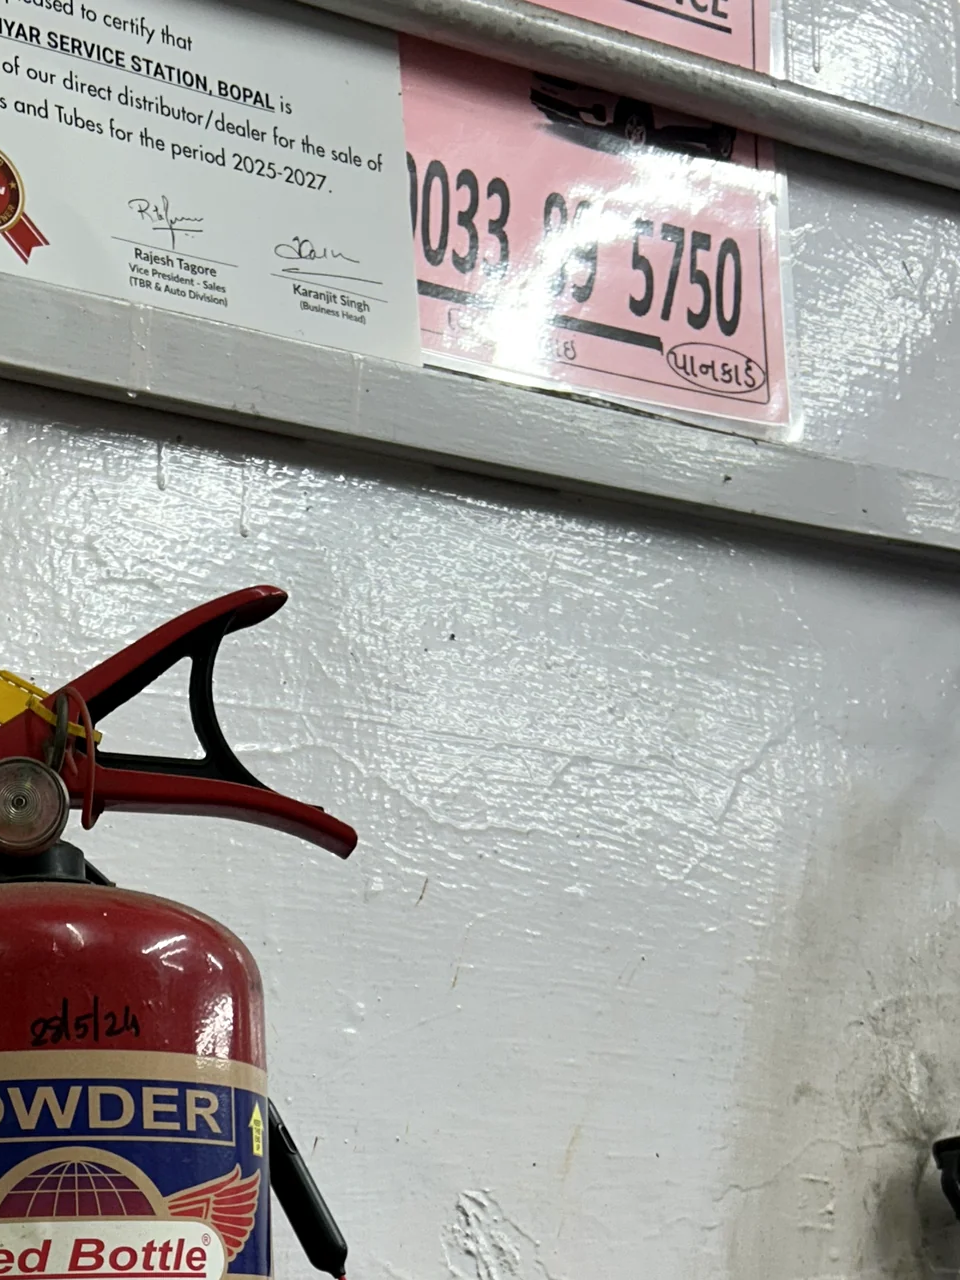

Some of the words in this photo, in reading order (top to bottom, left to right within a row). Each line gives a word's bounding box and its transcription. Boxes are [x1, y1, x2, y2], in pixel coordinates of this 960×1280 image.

[80, 4, 97, 23] to
[103, 13, 156, 45] certify
[161, 24, 192, 51] that
[47, 32, 125, 68] SERVICE
[131, 55, 213, 96] STATION,
[218, 80, 275, 110] BOPAL
[280, 96, 292, 115] is
[2, 56, 20, 75] of
[26, 67, 56, 86] our
[63, 71, 112, 101] direct
[117, 86, 267, 142] distributor/dealer
[273, 126, 295, 150] for
[301, 135, 325, 158] the
[331, 147, 362, 167] sale
[367, 154, 383, 172] of
[14, 99, 48, 120] and
[54, 104, 103, 135] Tubes
[109, 118, 133, 143] for
[139, 127, 165, 152] the
[171, 143, 225, 167] period
[128, 263, 150, 278] Vice
[151, 268, 194, 287] President
[203, 280, 226, 294] Sales
[134, 247, 174, 269] Rajesh
[176, 257, 217, 278] Tagore
[628, 217, 741, 337] 5750
[129, 277, 152, 291] (TBR
[164, 284, 187, 299] Auto
[189, 289, 228, 308] Division)
[293, 284, 338, 305] Karanjit
[340, 295, 370, 313] Singh
[299, 301, 340, 319] (Business
[341, 311, 367, 325] Head)
